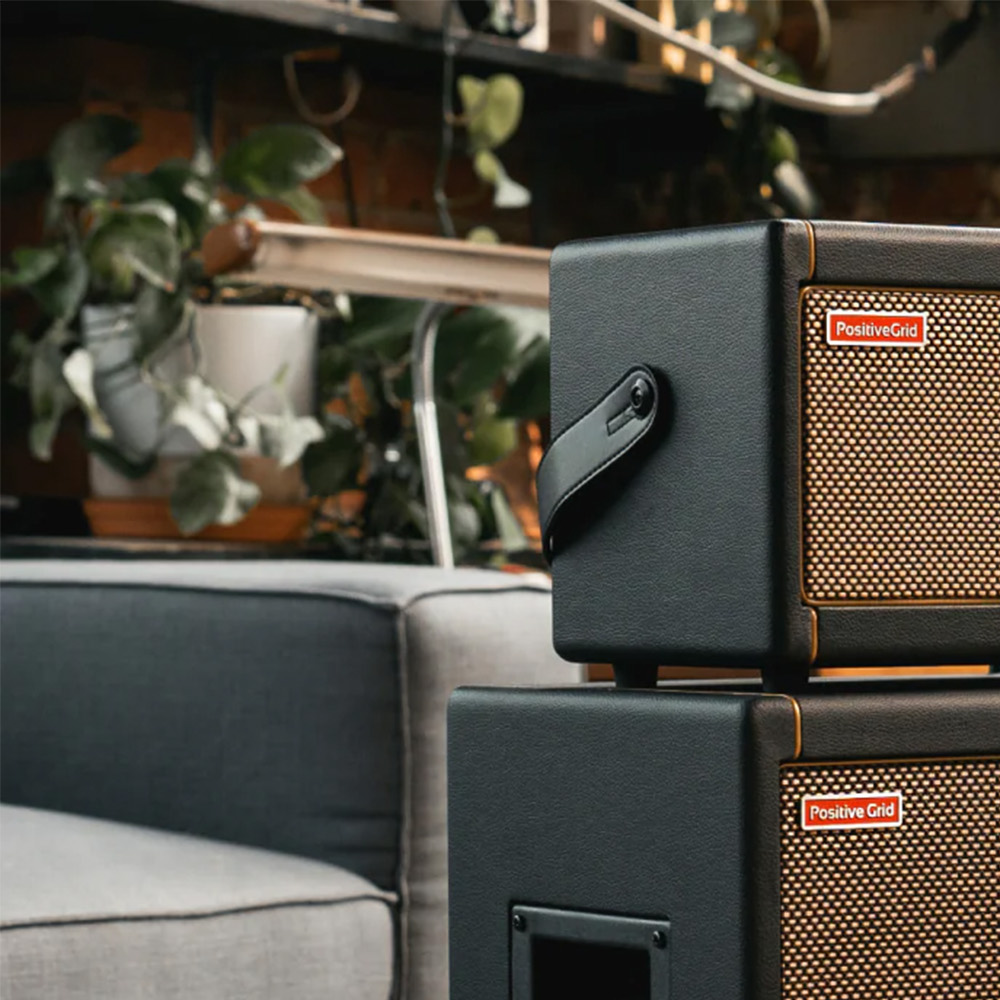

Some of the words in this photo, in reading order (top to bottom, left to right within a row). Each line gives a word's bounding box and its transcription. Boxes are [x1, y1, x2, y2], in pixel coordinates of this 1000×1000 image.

[836, 321, 918, 337] PositiveGrid
[810, 804, 864, 820] Positive
[867, 802, 894, 818] Grid
